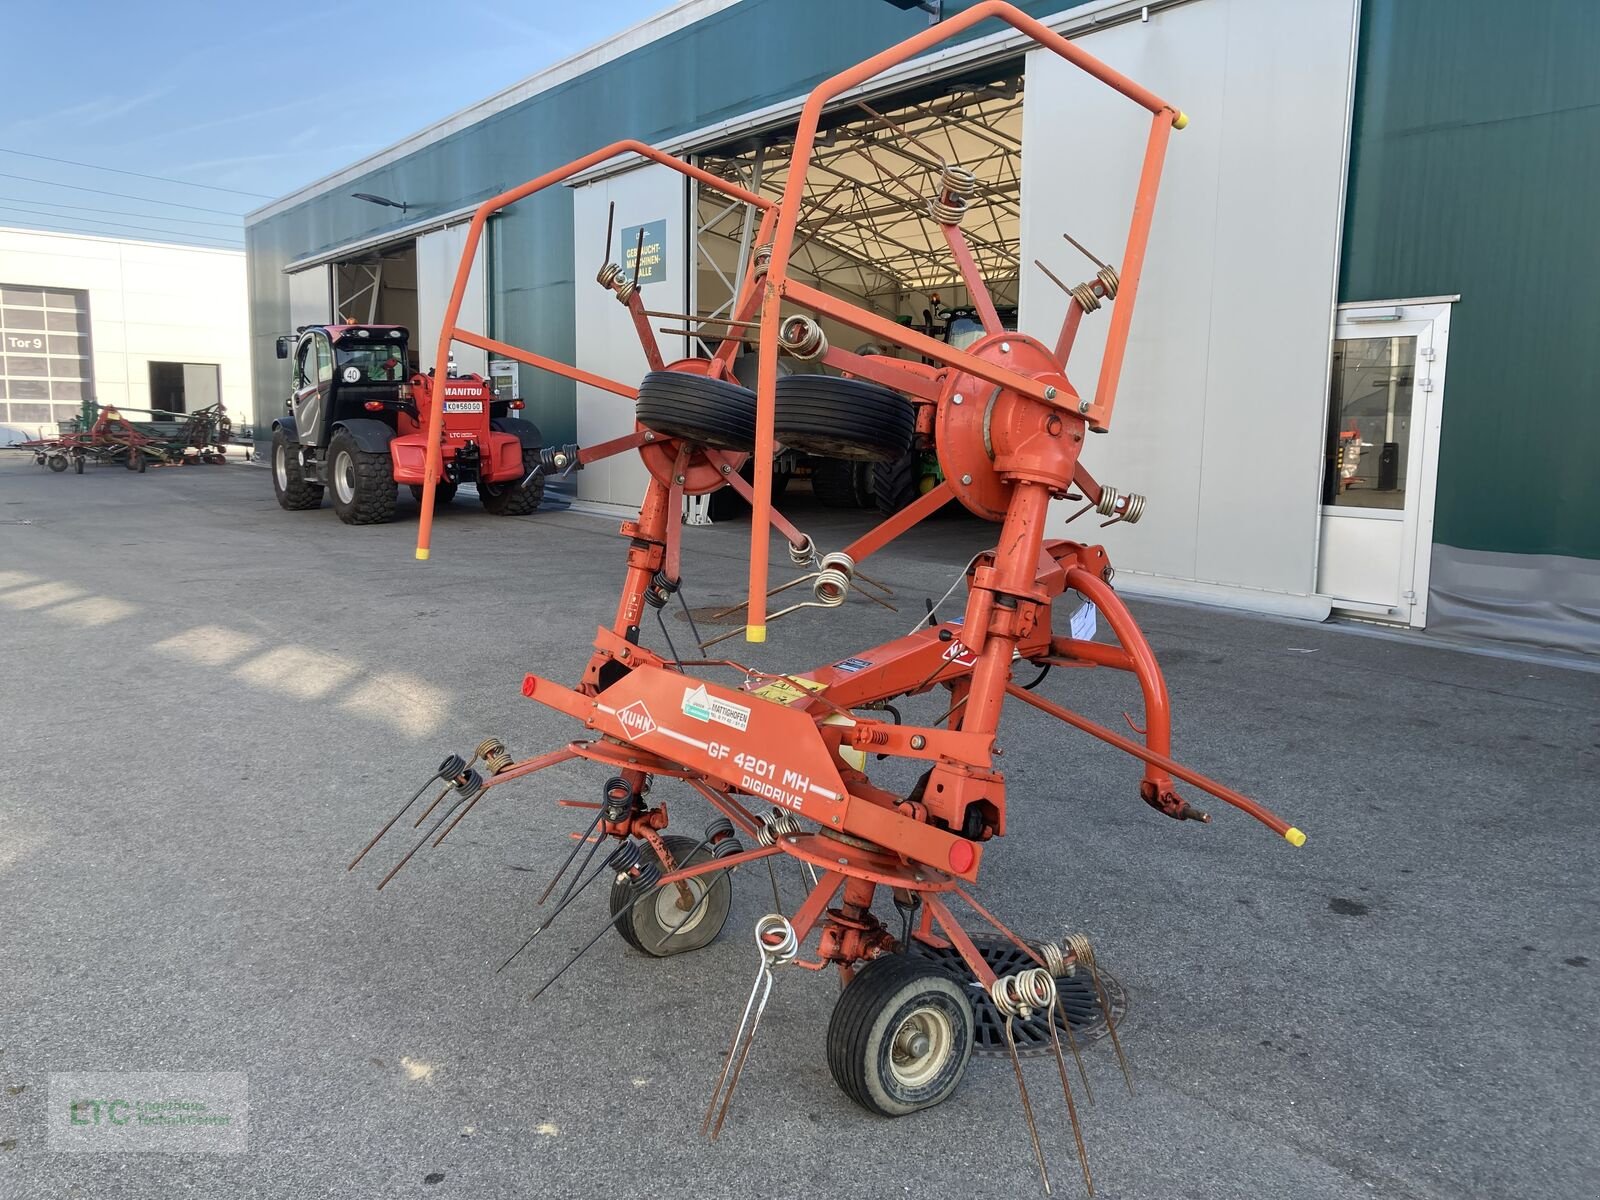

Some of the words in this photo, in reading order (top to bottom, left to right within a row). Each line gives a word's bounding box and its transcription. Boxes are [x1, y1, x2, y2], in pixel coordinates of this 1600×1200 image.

[626, 243, 661, 259] GEBAUCHT-
[636, 266, 652, 278] ALLE
[8, 337, 31, 348] Tor
[33, 338, 42, 349] 9
[347, 370, 358, 380] 40
[445, 387, 482, 396] MANITOU
[620, 708, 652, 732] KUHN
[711, 703, 748, 723] MATTIGHOFEN
[708, 741, 731, 760] GF
[733, 752, 776, 780] 4201
[782, 768, 810, 793] MH
[741, 775, 804, 810] DIGIDRIVE
